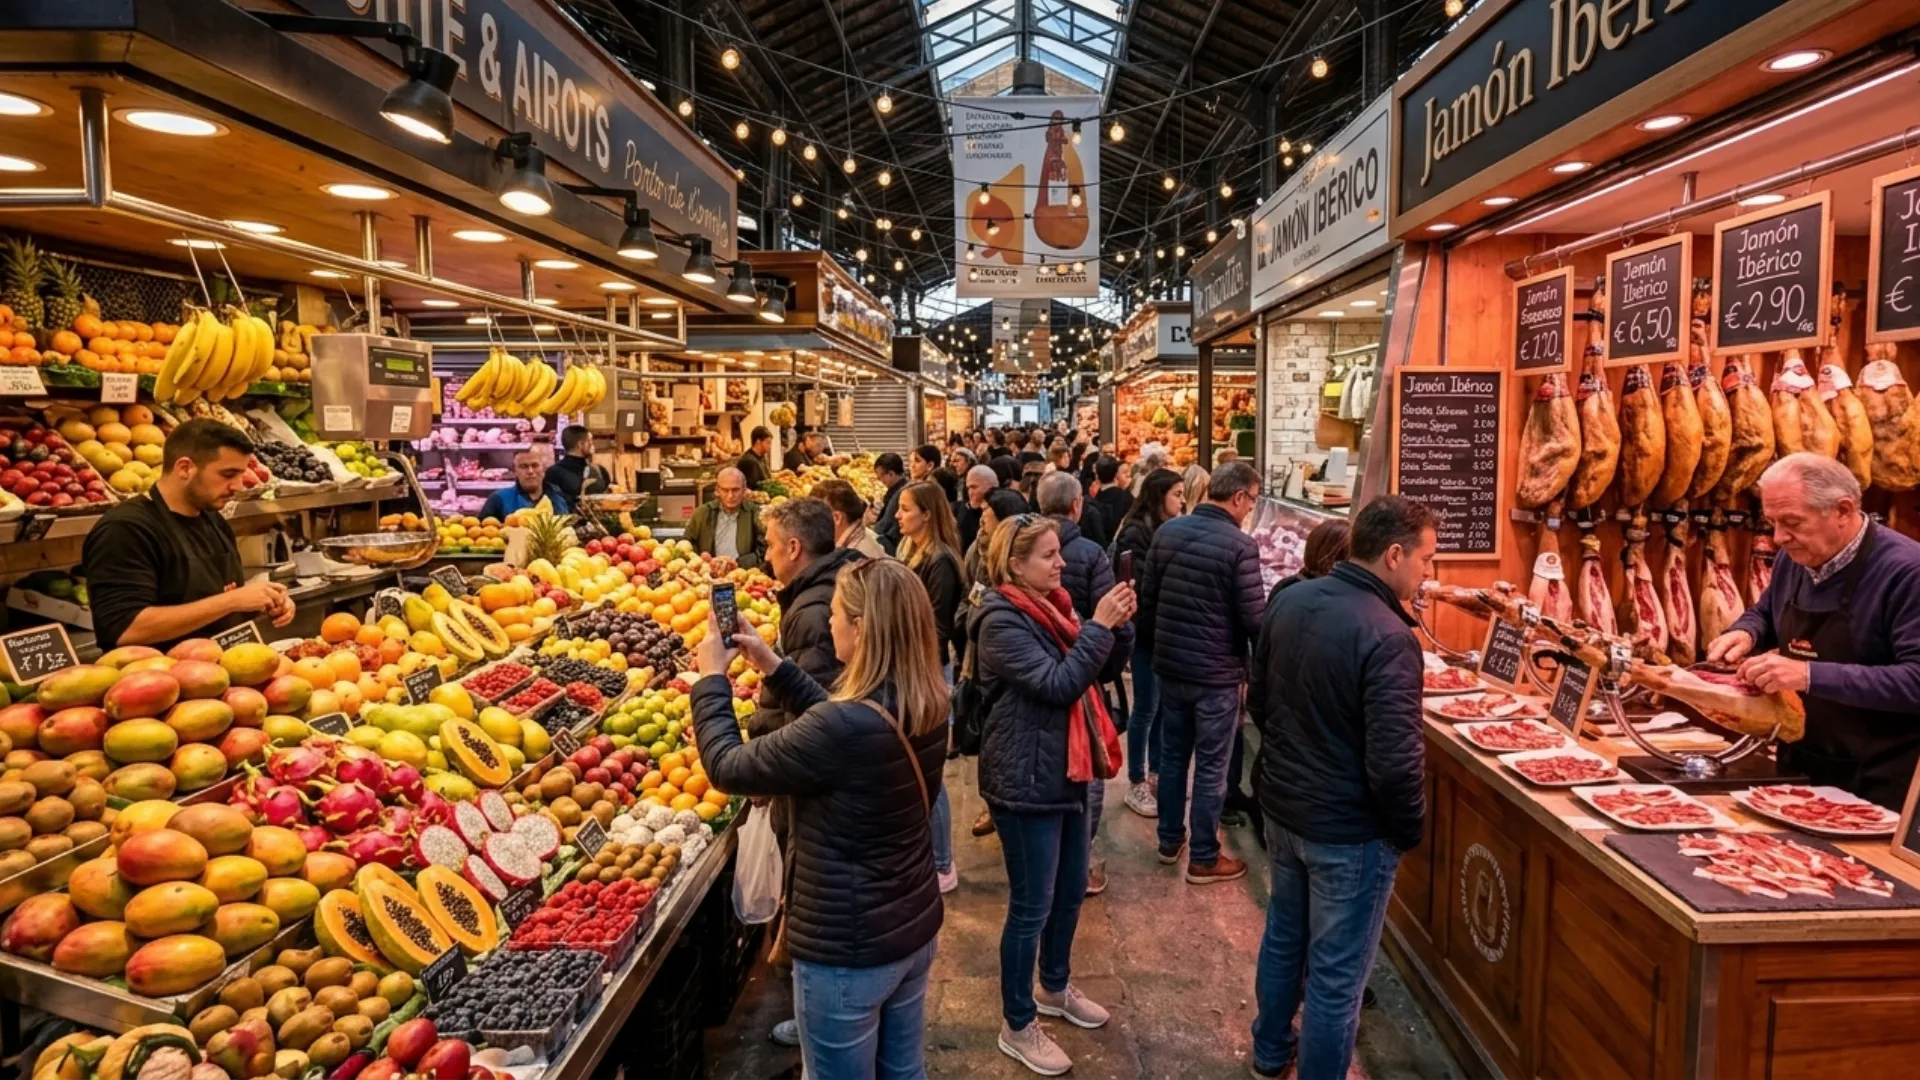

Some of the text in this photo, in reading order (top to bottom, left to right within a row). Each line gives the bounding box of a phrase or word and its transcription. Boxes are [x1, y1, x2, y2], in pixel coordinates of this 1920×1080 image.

[479, 12, 502, 102] &
[513, 39, 611, 173] AIROTS
[1420, 40, 1534, 187] Jamón
[1270, 200, 1310, 264] JAMÓN
[1314, 147, 1378, 236] IBÉRICO
[1737, 219, 1799, 253] Jamón
[1736, 249, 1803, 280] Ibérico
